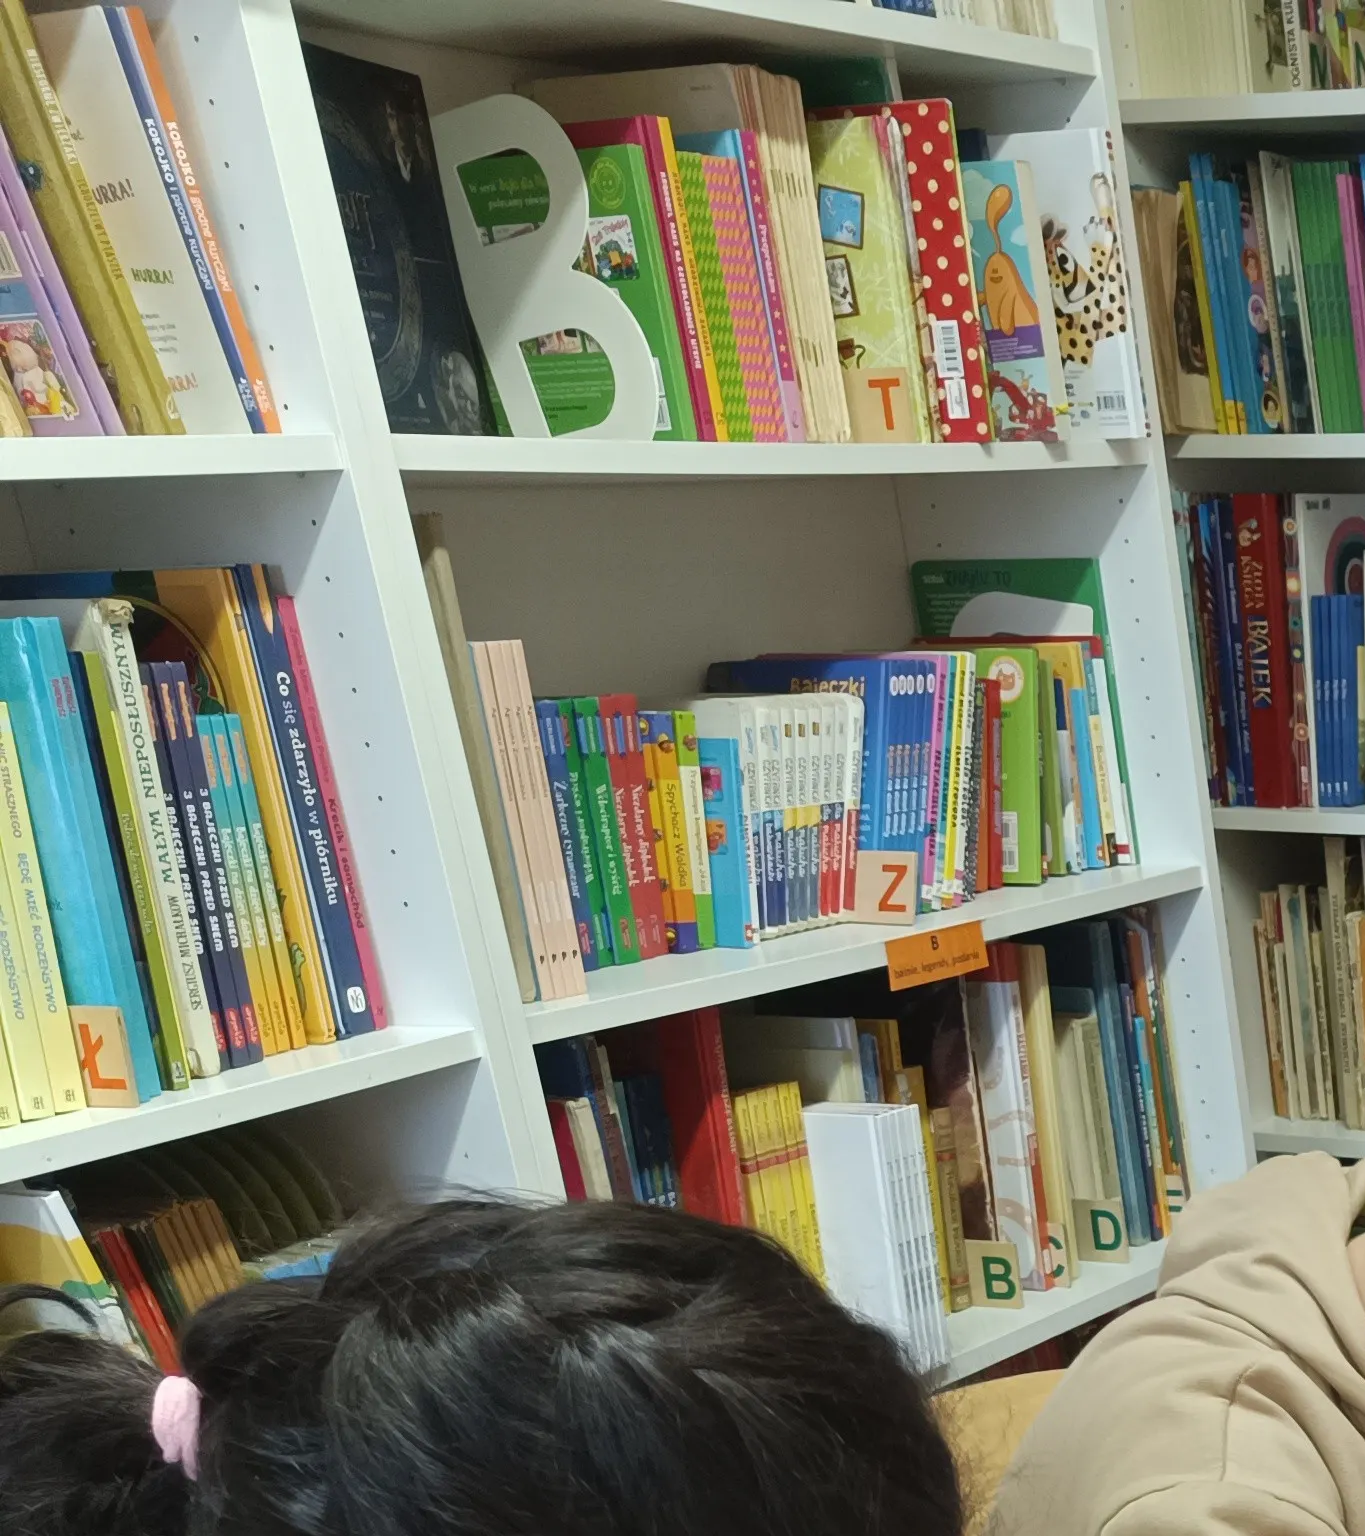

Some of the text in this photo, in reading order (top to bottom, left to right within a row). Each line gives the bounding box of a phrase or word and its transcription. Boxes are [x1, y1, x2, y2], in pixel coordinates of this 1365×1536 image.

[143, 116, 174, 184] KOKOJKO
[164, 120, 196, 187] KOKOJKO
[93, 178, 135, 205] URRA!
[868, 377, 901, 431] T
[274, 670, 292, 697] Co
[1245, 618, 1274, 707] BAJEK
[108, 621, 156, 799] NIEPOSŁUSZNYM
[279, 698, 298, 725] się
[198, 787, 208, 796] 3
[285, 726, 318, 807] zdarzyło
[182, 790, 191, 799] 3
[307, 809, 319, 826] w
[147, 808, 174, 884] MAŁYM
[185, 803, 206, 866] BAJECZKI
[201, 800, 222, 863] BAJECZKI
[663, 782, 689, 887] Spychacz Waldka
[199, 869, 216, 910] PRZED
[215, 866, 232, 908] PRZED
[308, 826, 342, 905] piórniku
[877, 864, 908, 913] Z
[30, 923, 58, 1014] RODZEŃSTWO
[930, 935, 939, 950] B
[77, 1023, 128, 1090] Ł
[1090, 1208, 1123, 1251] D
[981, 1255, 1017, 1300] B
